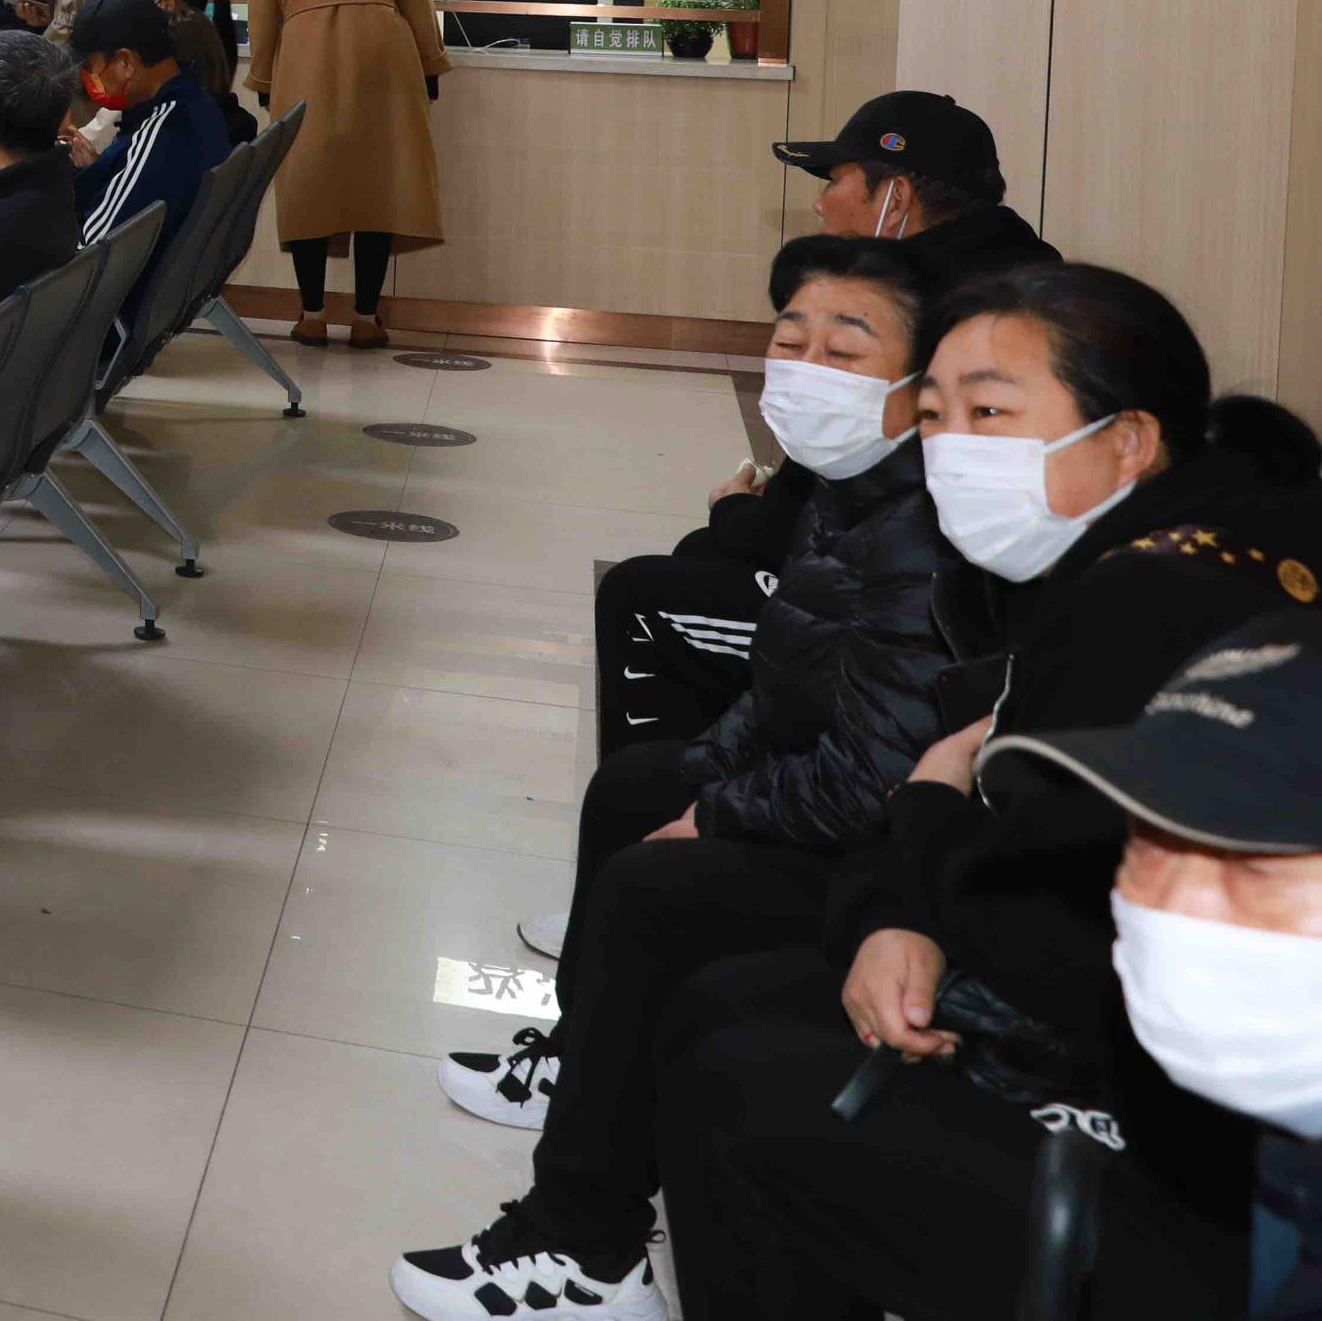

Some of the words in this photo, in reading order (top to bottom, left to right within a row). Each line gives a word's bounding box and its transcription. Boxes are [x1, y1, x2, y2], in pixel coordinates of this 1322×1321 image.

[575, 28, 657, 49] 请自觉排队
